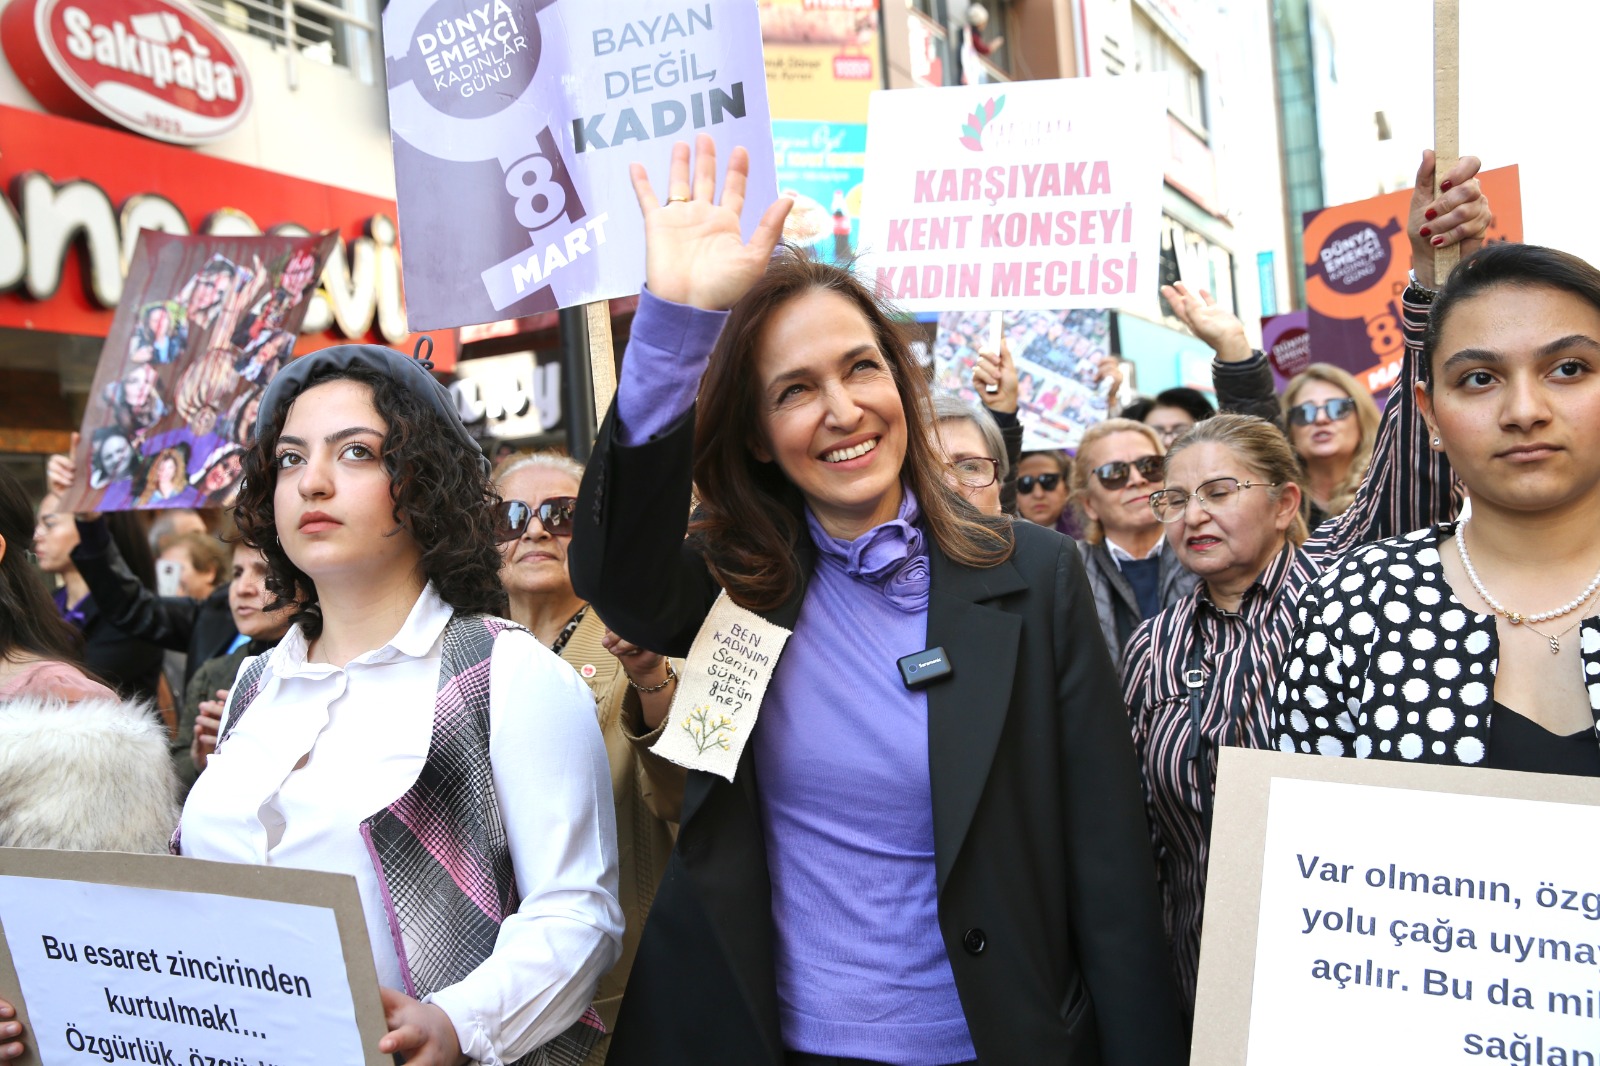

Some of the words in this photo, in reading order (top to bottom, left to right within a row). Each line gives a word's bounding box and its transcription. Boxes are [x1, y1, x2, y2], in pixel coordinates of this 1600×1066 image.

[416, 0, 512, 56] DÜNYA
[425, 12, 519, 76] EMEKÇİ
[592, 3, 714, 57] BAYAN
[433, 36, 528, 92] KADINLAR
[460, 61, 512, 98] GÜNÜ
[604, 48, 717, 100] DEĞİL,
[572, 81, 747, 155] KADIN
[504, 154, 566, 230] 8
[914, 160, 1112, 206] KARŞIYAKA
[886, 215, 973, 252] KENT
[980, 202, 1133, 248] KONSEYİ
[1320, 227, 1378, 262] DÜNYA
[511, 212, 610, 294] MART
[874, 263, 982, 300] KADIN
[990, 252, 1138, 297] MECLİSİ
[1325, 238, 1381, 274] EMEKÇİ
[1366, 313, 1403, 355] 8
[1367, 357, 1404, 390] MA
[713, 631, 769, 666] KADINIM
[731, 623, 761, 647] BEN
[712, 647, 758, 680] Senin
[709, 680, 752, 702] gücün
[1296, 853, 1354, 884] Var
[1364, 863, 1522, 909] olmanın,
[1301, 906, 1377, 937] yolu
[1389, 917, 1477, 953] çağa
[1490, 931, 1600, 973] uyma
[42, 935, 78, 963] Bu
[84, 944, 162, 974] esaret
[166, 950, 312, 998] zincirinden
[1311, 957, 1409, 992] açılır.
[1423, 967, 1473, 1000] Bu
[1487, 977, 1535, 1010] da
[1548, 989, 1600, 1019] mi
[1463, 1031, 1600, 1066] sağlan
